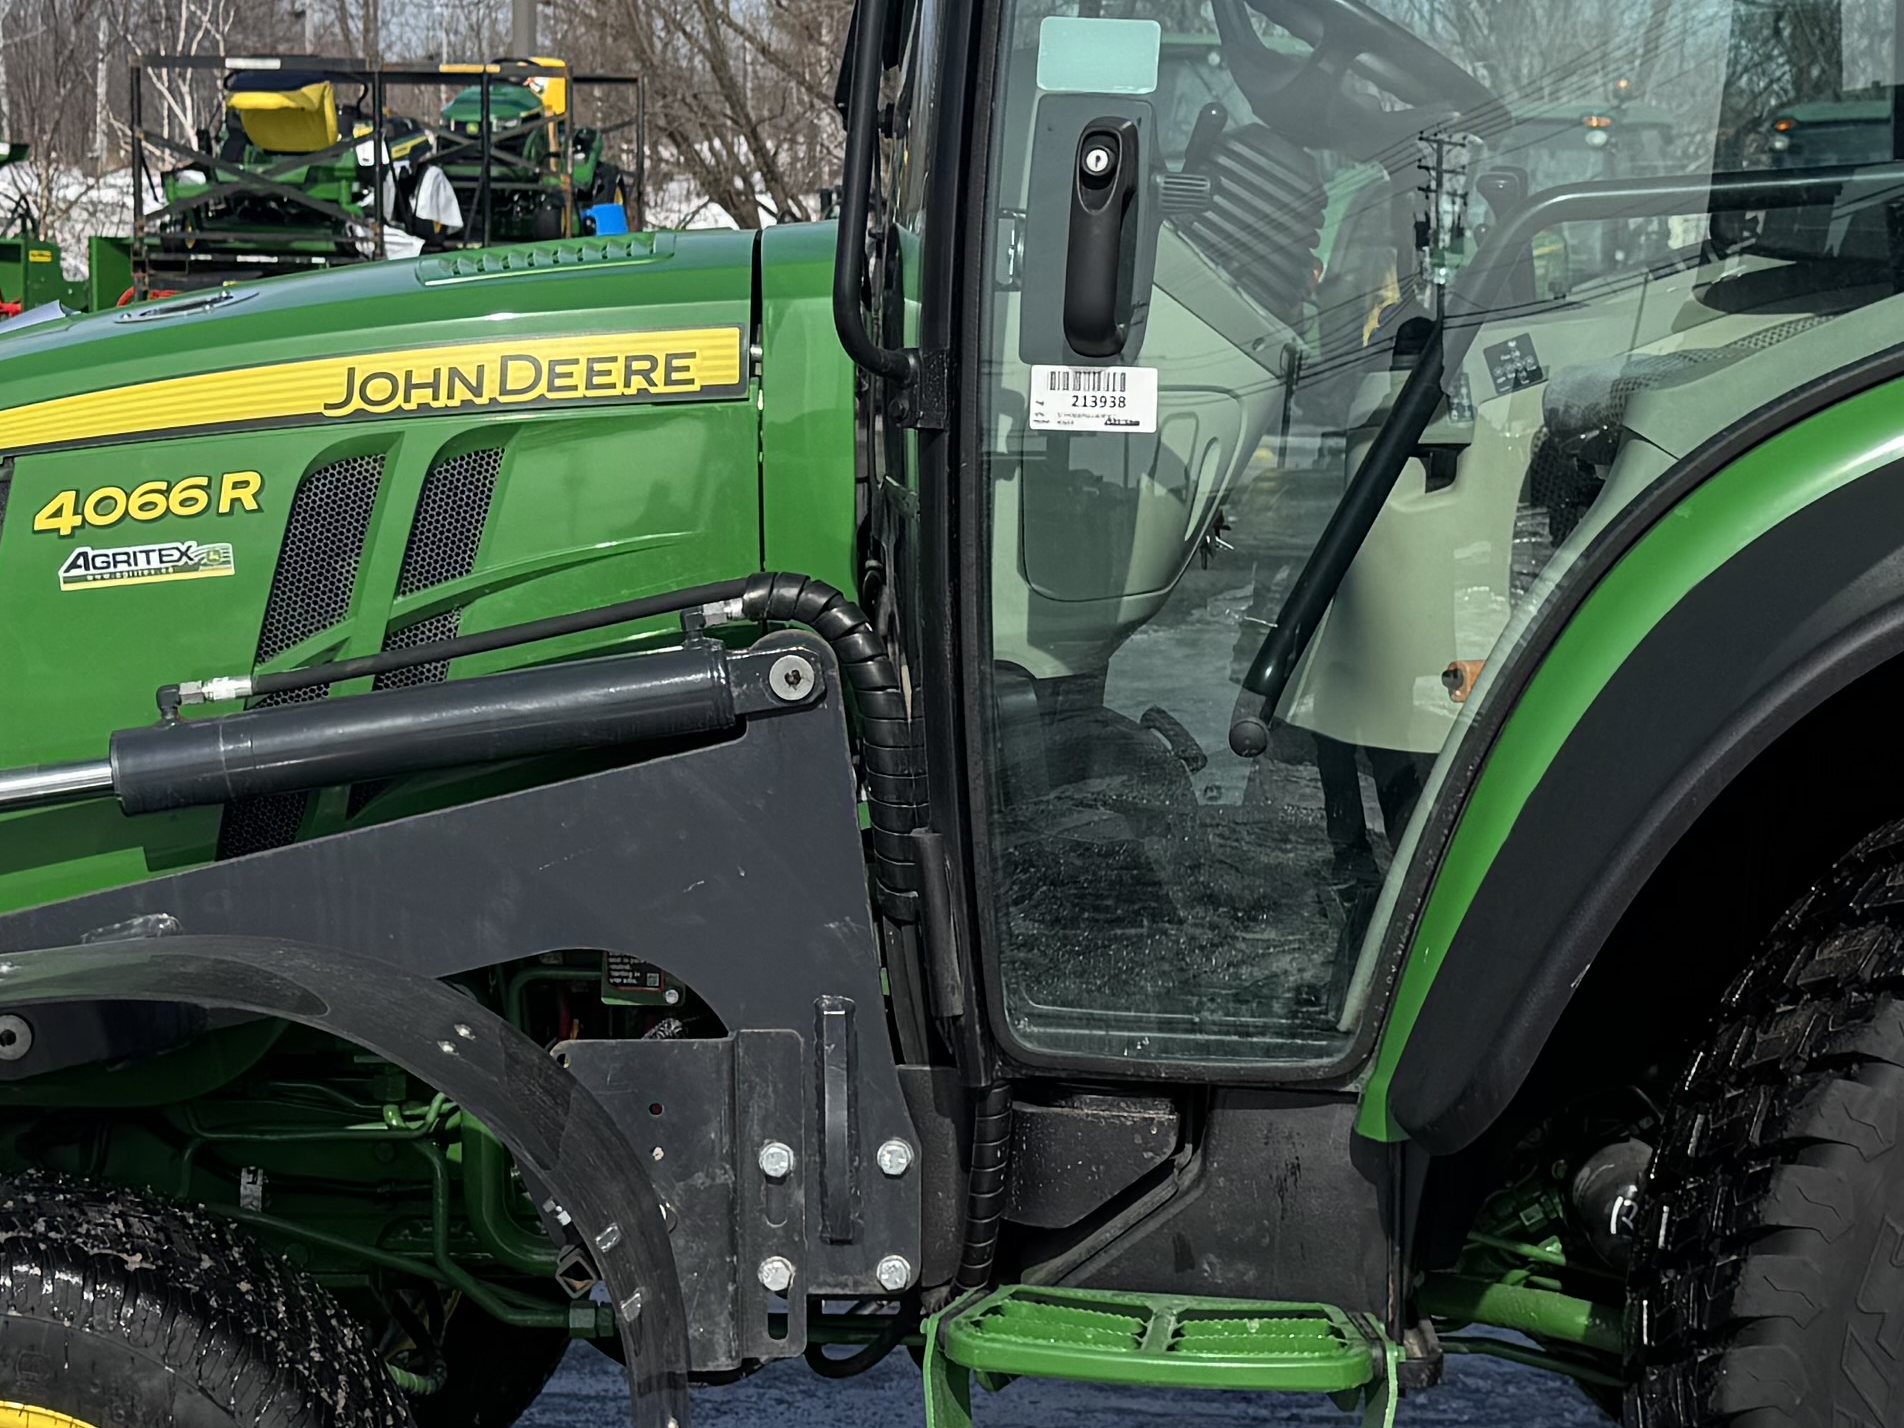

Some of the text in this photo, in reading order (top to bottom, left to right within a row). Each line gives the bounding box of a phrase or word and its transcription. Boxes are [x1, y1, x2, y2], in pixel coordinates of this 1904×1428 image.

[323, 351, 697, 410] JOHN DEERE
[1071, 395, 1127, 408] 213938
[63, 545, 195, 574] AGRITEX
